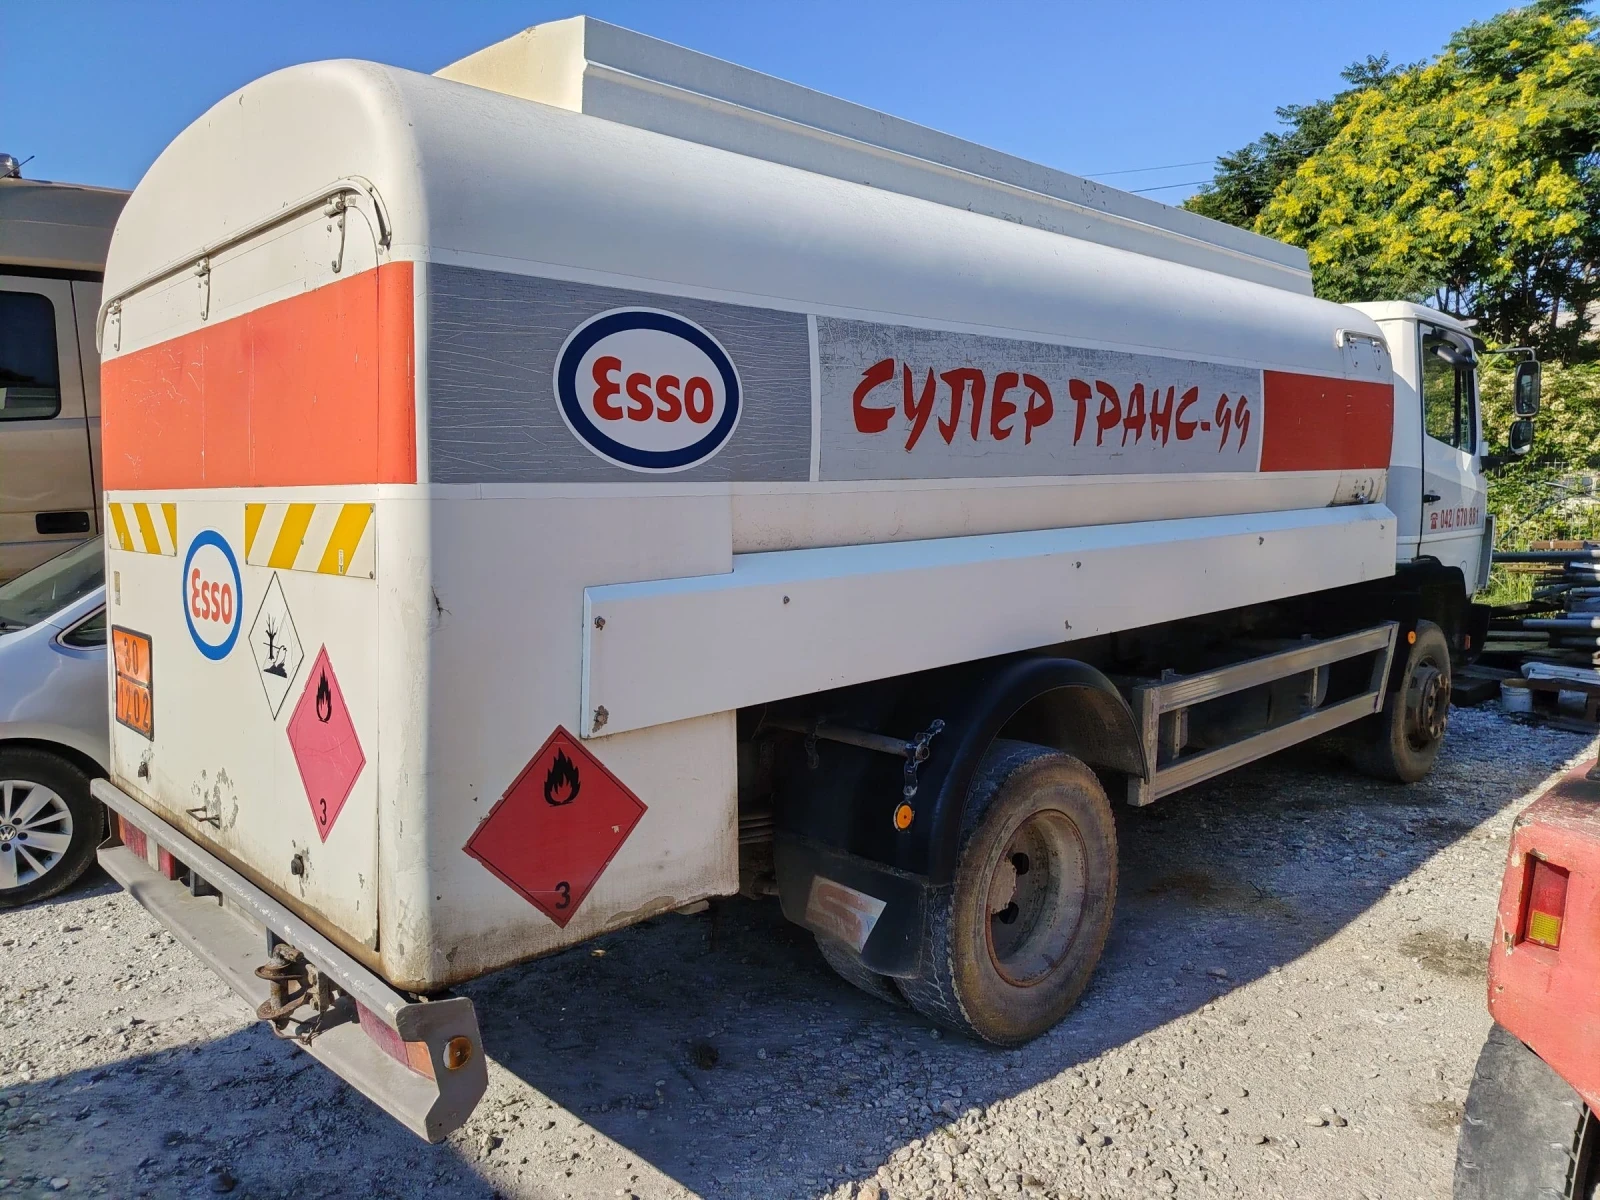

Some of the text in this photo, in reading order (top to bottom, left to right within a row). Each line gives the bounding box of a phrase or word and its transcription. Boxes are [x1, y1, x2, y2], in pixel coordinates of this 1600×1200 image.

[592, 356, 714, 424] Esso
[852, 358, 1250, 454] СУПЕР ТРАНС-99
[1456, 507, 1468, 527] 670
[191, 568, 233, 625] Esso
[123, 637, 139, 675] 30
[119, 681, 150, 728] 1202
[320, 798, 327, 825] 3
[554, 881, 571, 909] 3
